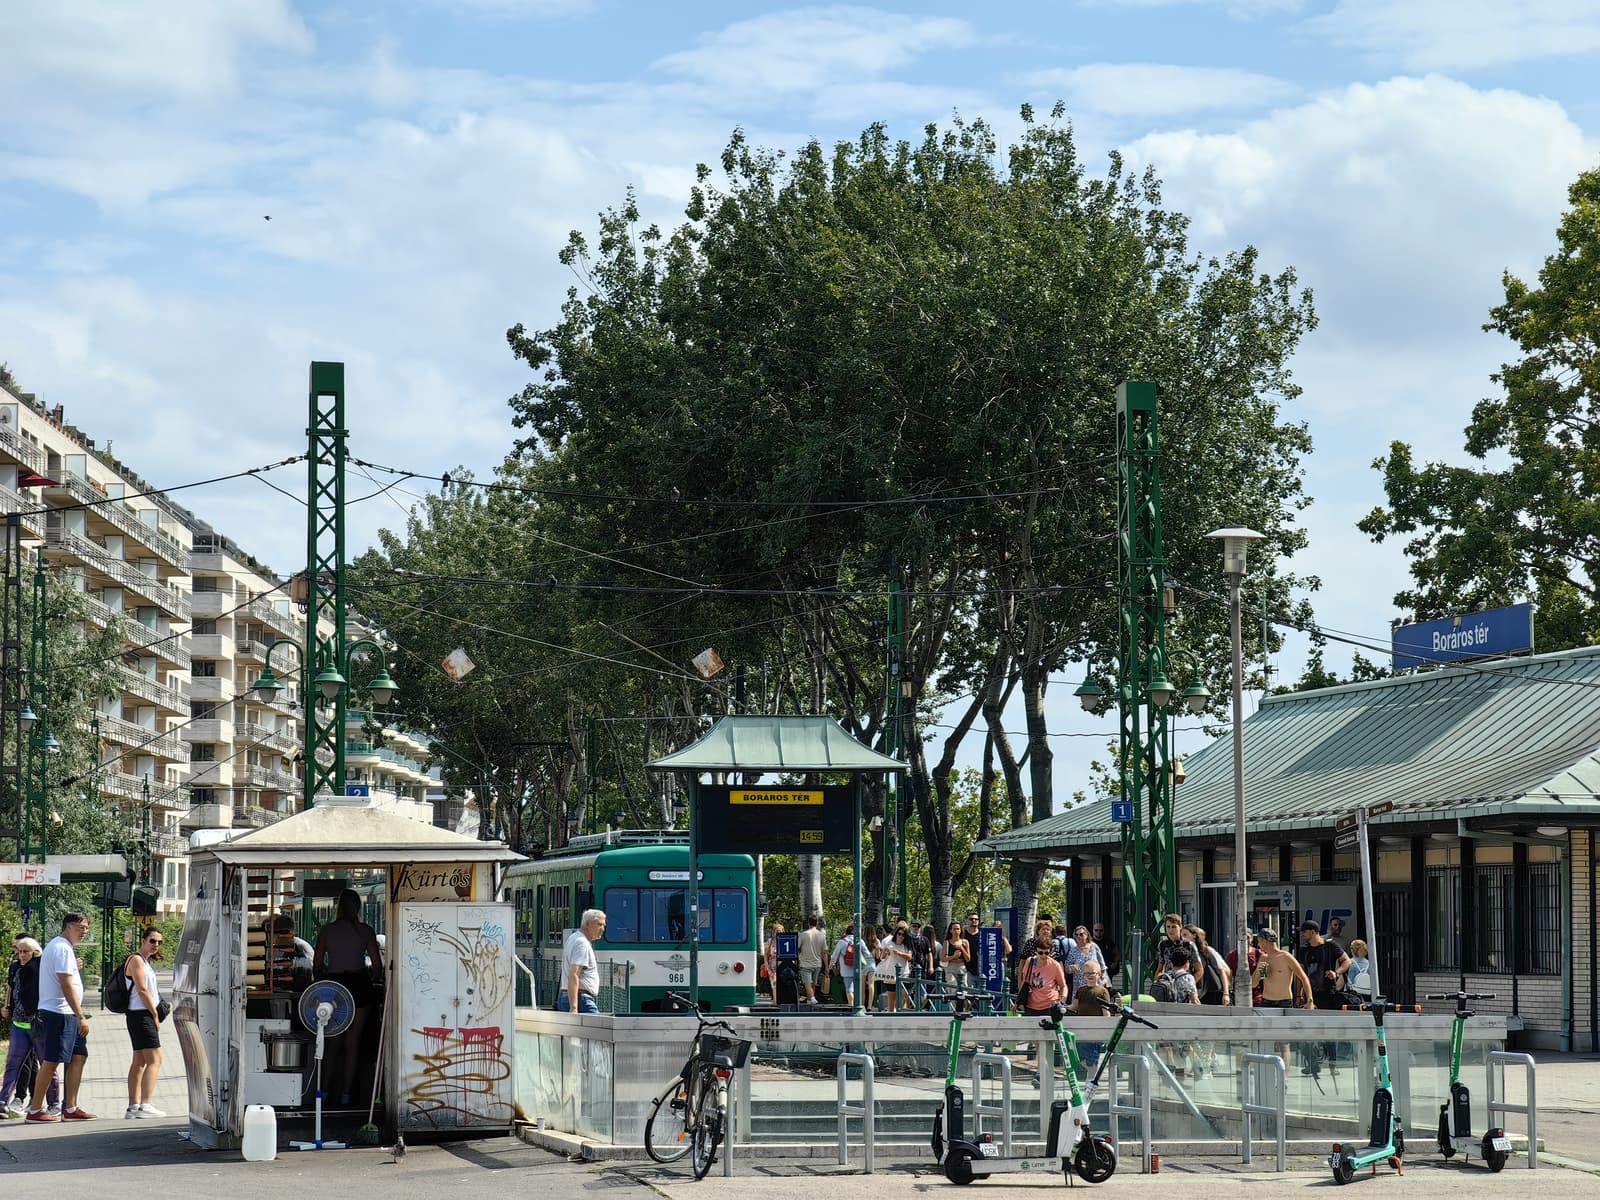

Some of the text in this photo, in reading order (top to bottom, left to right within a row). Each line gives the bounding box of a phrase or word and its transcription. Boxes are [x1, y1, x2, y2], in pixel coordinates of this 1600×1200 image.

[1432, 622, 1489, 652] Boráros tér
[353, 788, 362, 797] 2
[743, 793, 810, 801] BORÁROS TÉR
[402, 869, 471, 890] Kürtős
[783, 941, 790, 953] 1
[668, 973, 685, 983] 968
